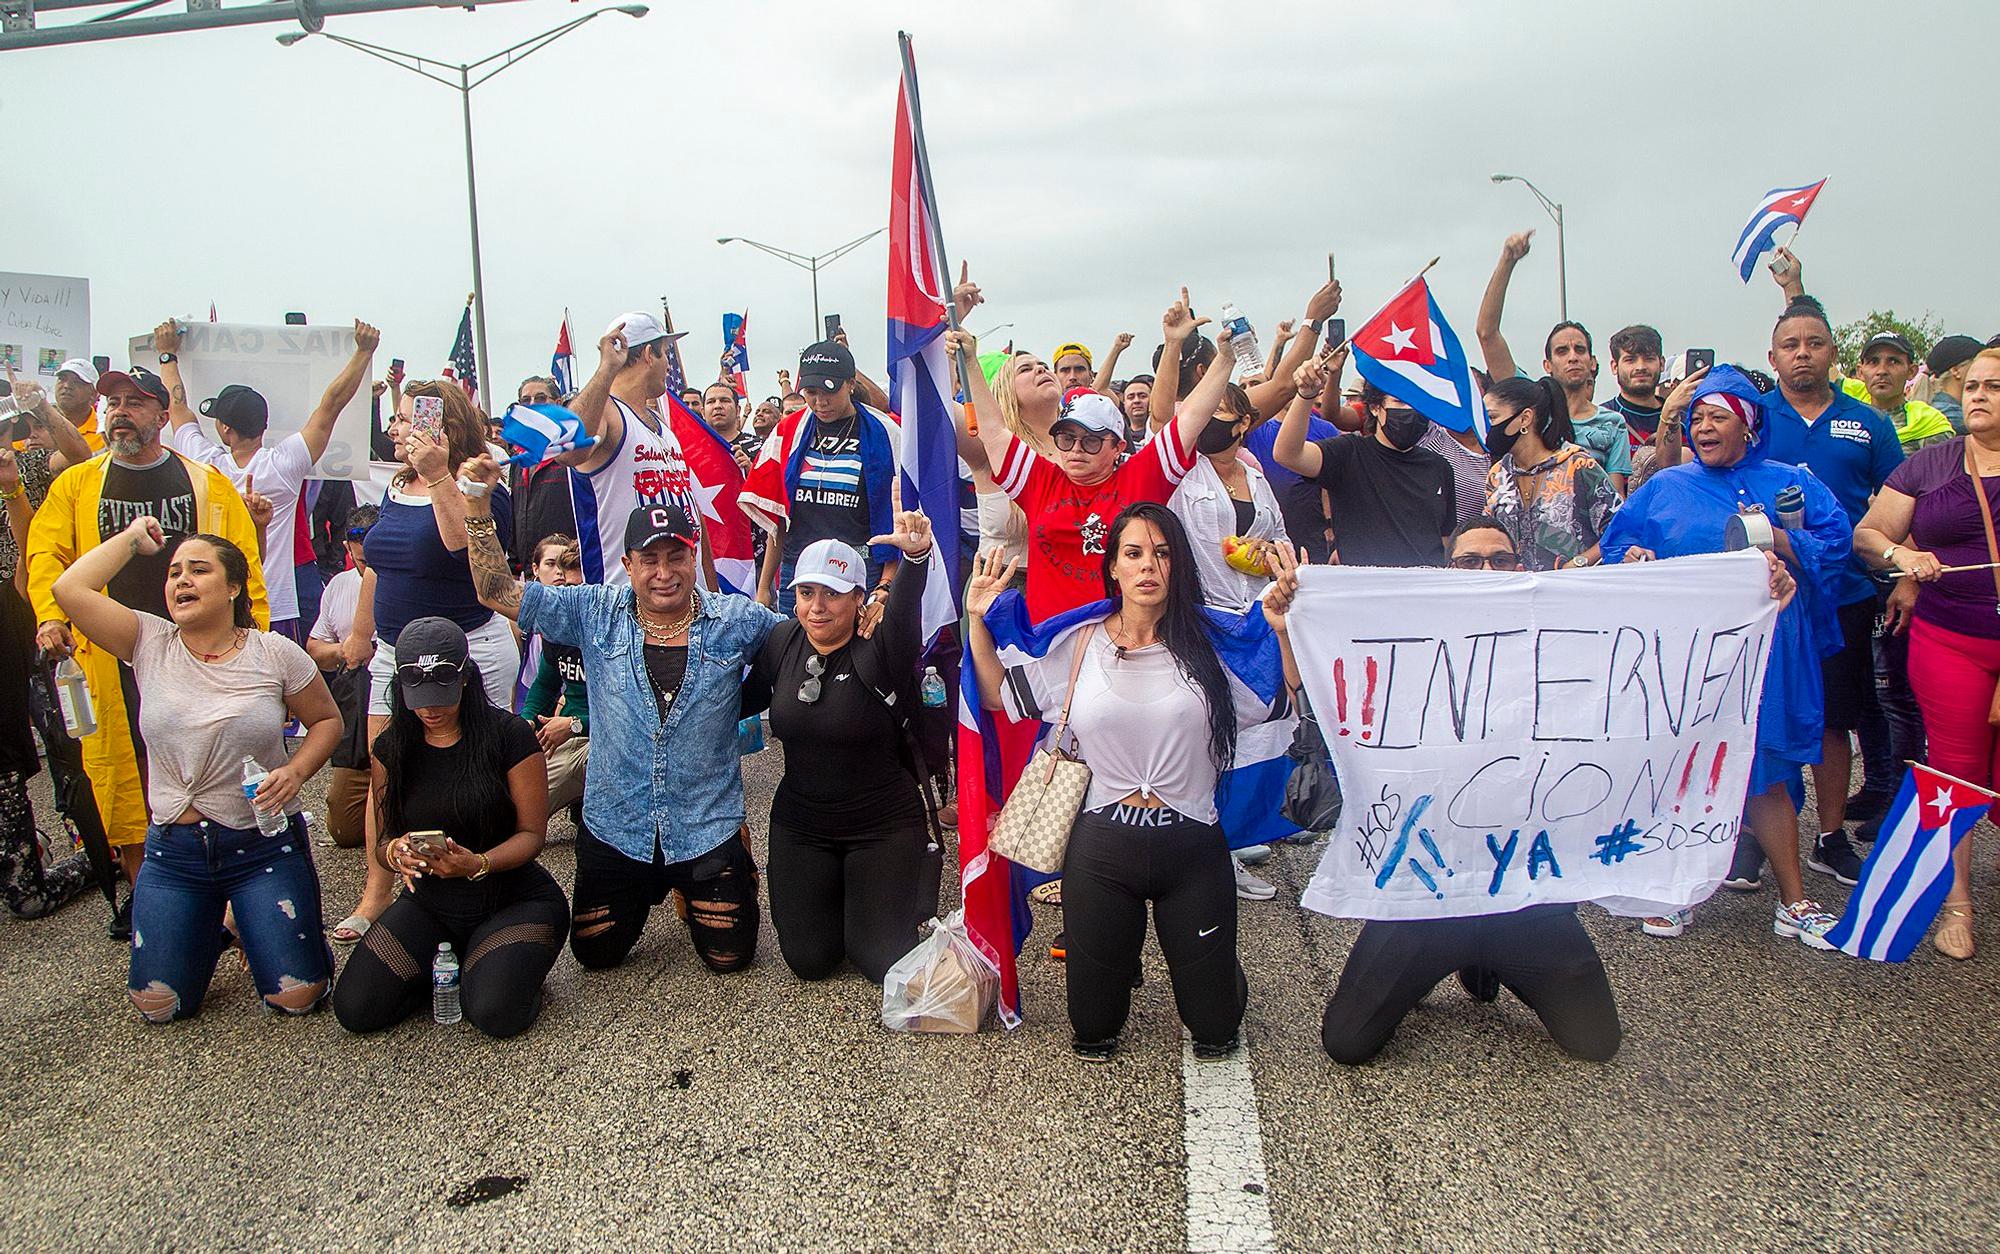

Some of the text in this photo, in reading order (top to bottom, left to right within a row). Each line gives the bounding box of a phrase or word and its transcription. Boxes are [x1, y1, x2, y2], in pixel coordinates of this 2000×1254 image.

[815, 490, 860, 508] LIBRE!!
[651, 508, 669, 529] C
[829, 558, 849, 575] mvp
[418, 654, 440, 667] NIKE
[1110, 803, 1173, 828] NIKE
[1485, 829, 1563, 897] YA
